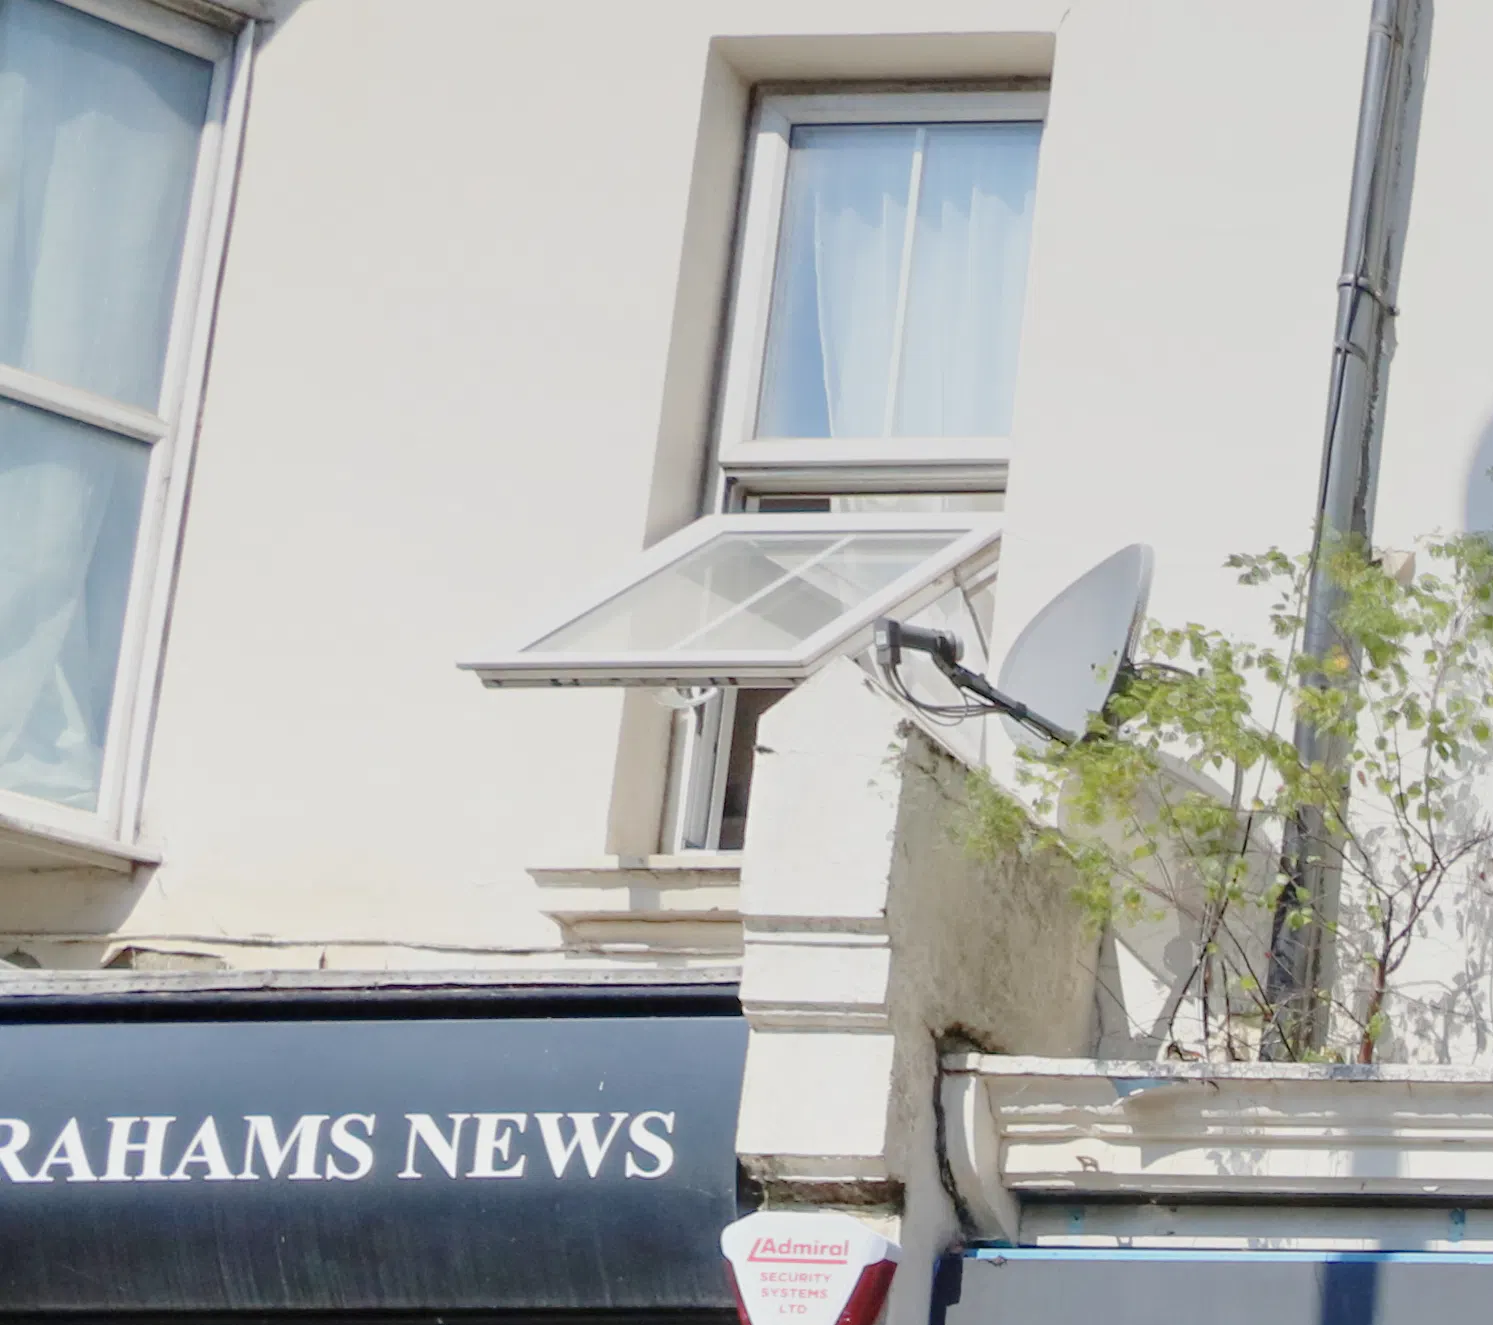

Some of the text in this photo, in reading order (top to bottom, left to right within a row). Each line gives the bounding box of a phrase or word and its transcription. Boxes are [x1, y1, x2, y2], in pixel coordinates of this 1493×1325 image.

[0, 1110, 675, 1183] RAHAMS NEWS
[759, 1237, 850, 1257] Admiral
[759, 1271, 833, 1283] SECURITY
[760, 1287, 829, 1300] SYSTEMS
[778, 1303, 808, 1315] LTD
